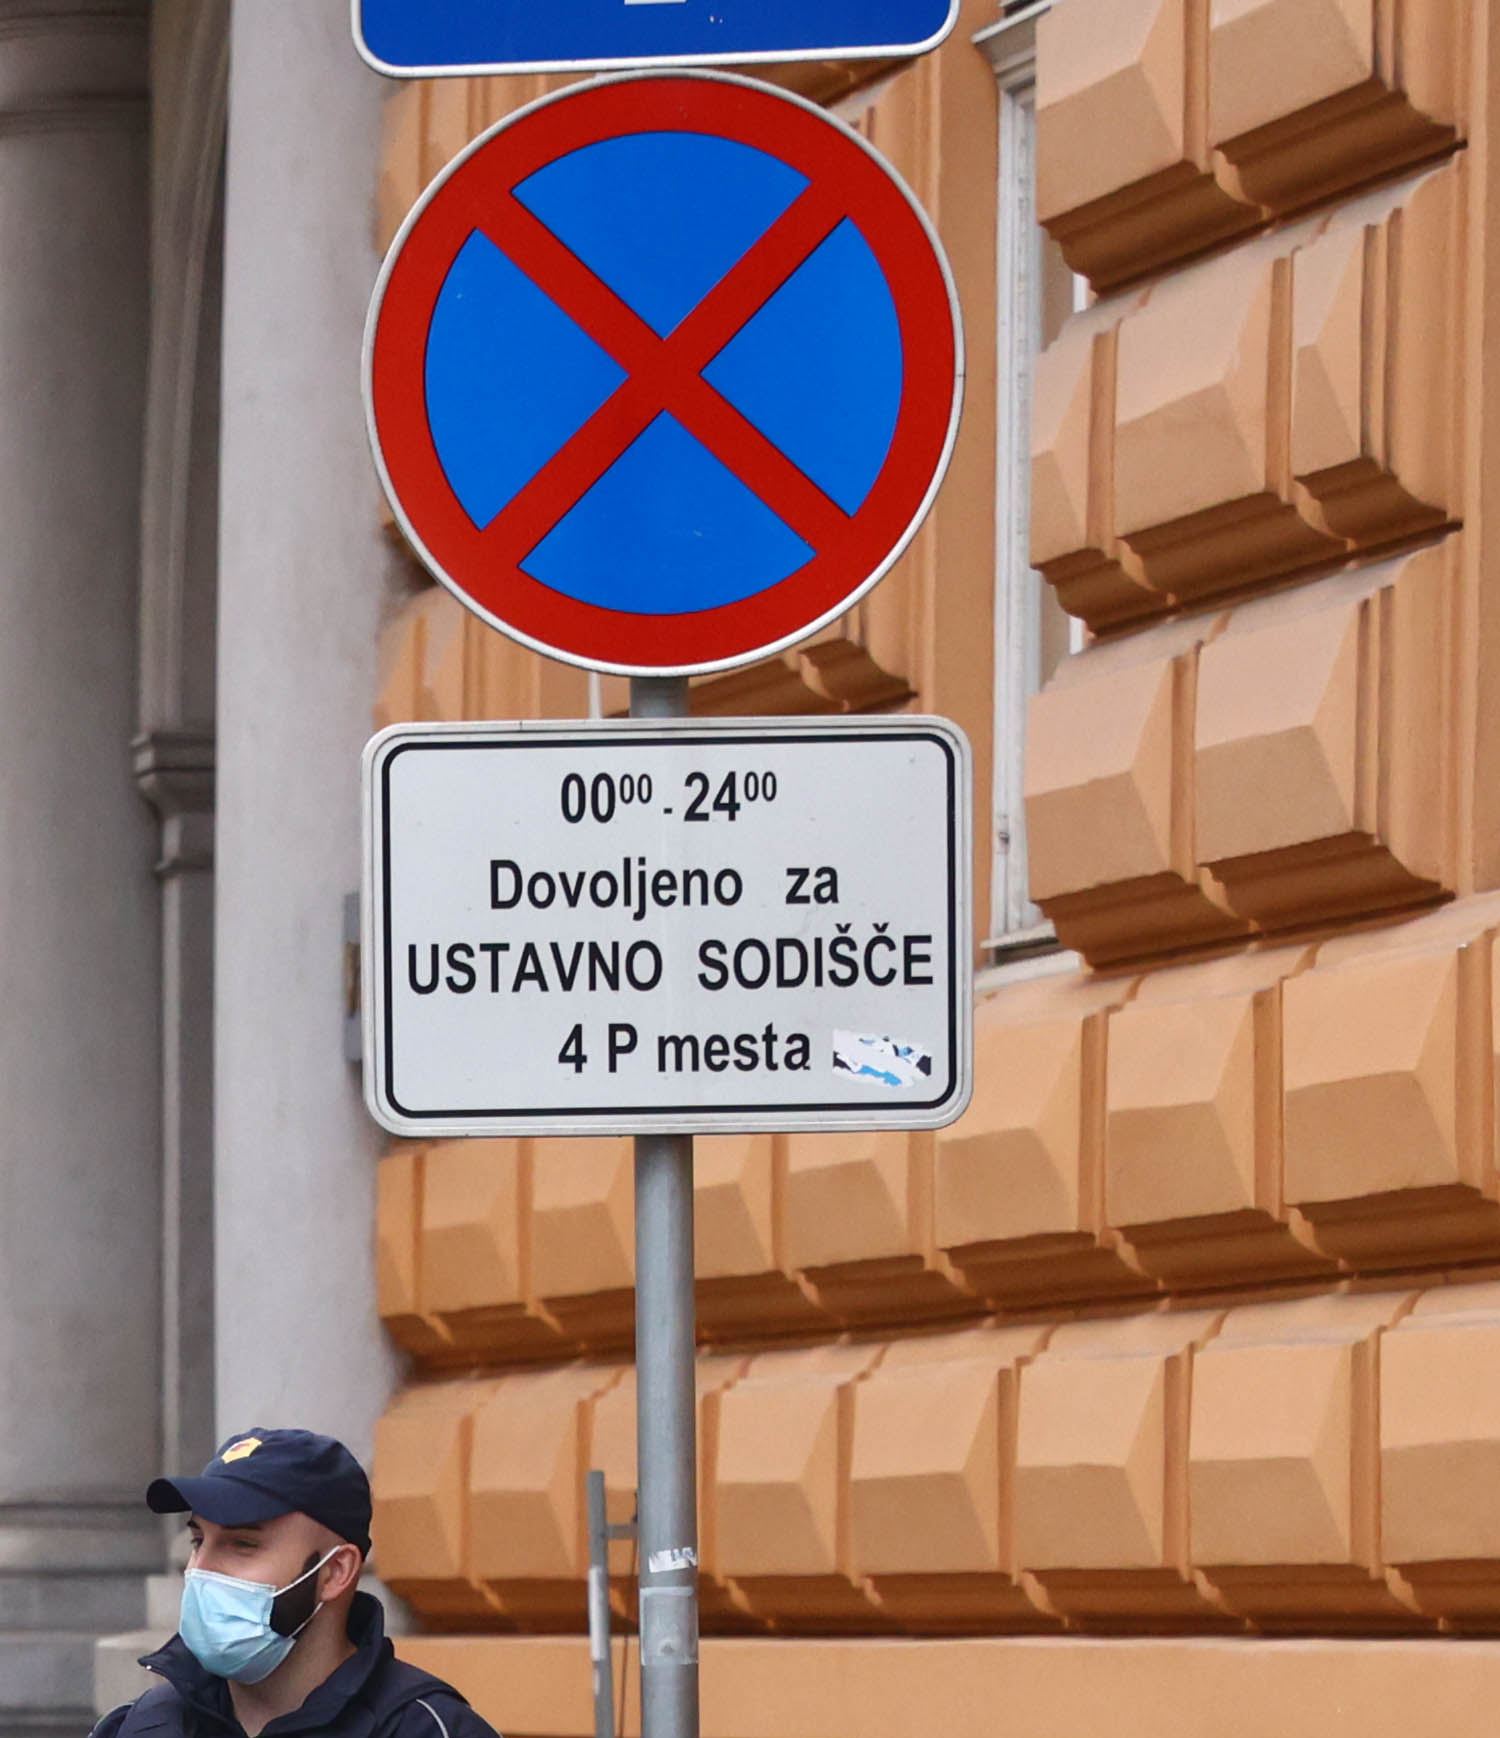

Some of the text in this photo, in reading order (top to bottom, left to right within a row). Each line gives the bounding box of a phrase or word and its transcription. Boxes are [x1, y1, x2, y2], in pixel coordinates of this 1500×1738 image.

[490, 856, 839, 922] Dovoljeno za
[408, 922, 934, 995] USTAVNO SODIŠČE
[558, 1022, 811, 1074] 4 P mesta
